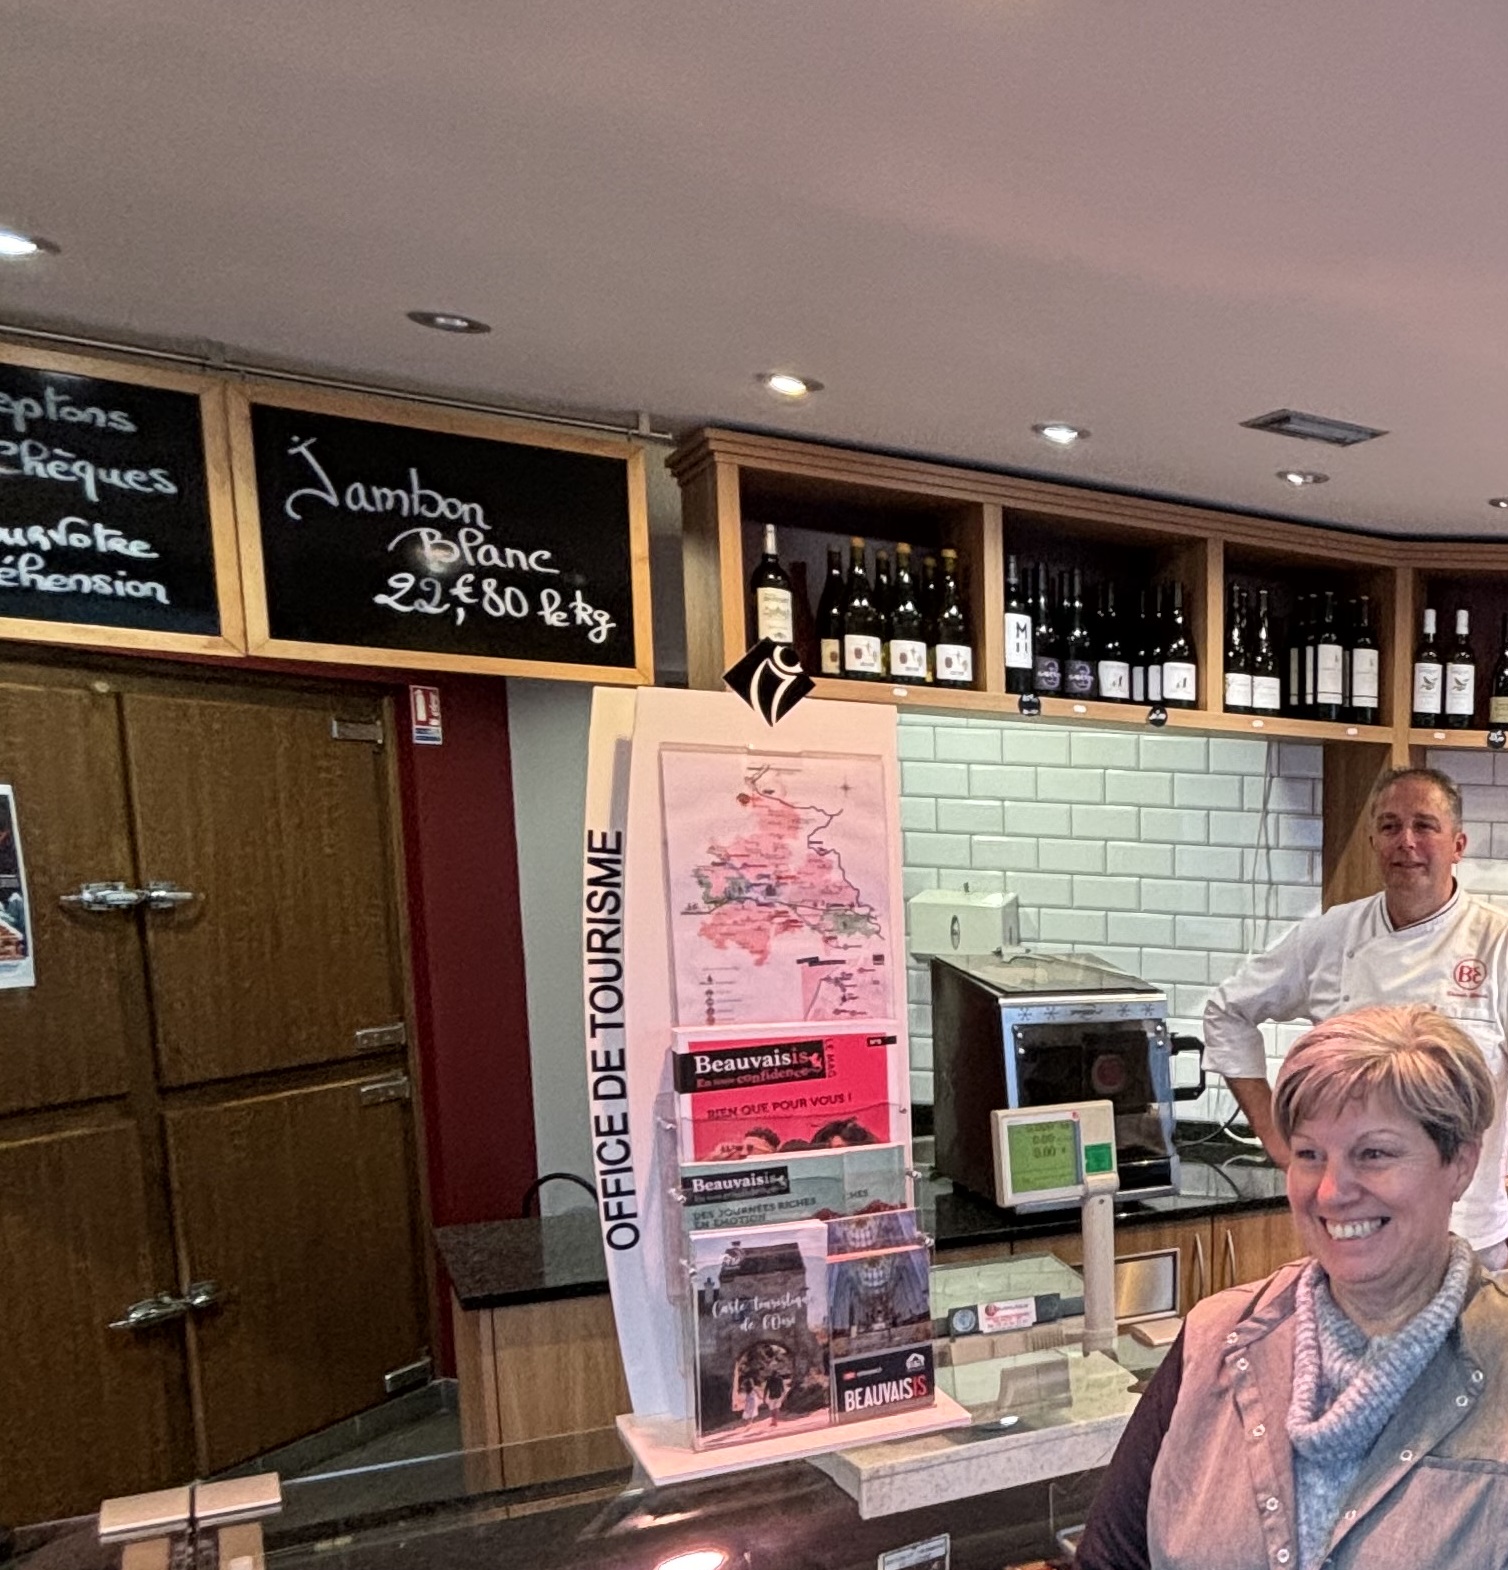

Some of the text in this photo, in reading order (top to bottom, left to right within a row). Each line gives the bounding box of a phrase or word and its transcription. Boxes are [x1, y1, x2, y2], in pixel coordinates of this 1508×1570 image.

[286, 436, 492, 530] Jambon
[388, 527, 560, 574] Blanc
[537, 588, 570, 627] le
[569, 590, 616, 644] kg
[586, 830, 640, 1251] OFFICE DE TOURISME
[694, 1047, 809, 1075] Beauvaisis
[741, 1102, 769, 1116] QUE
[772, 1098, 807, 1112] POUR
[810, 1093, 845, 1106] VOUS
[693, 1209, 715, 1221] DES
[778, 1197, 817, 1210] RICHES
[844, 1374, 928, 1413] BEAUVAISIS
